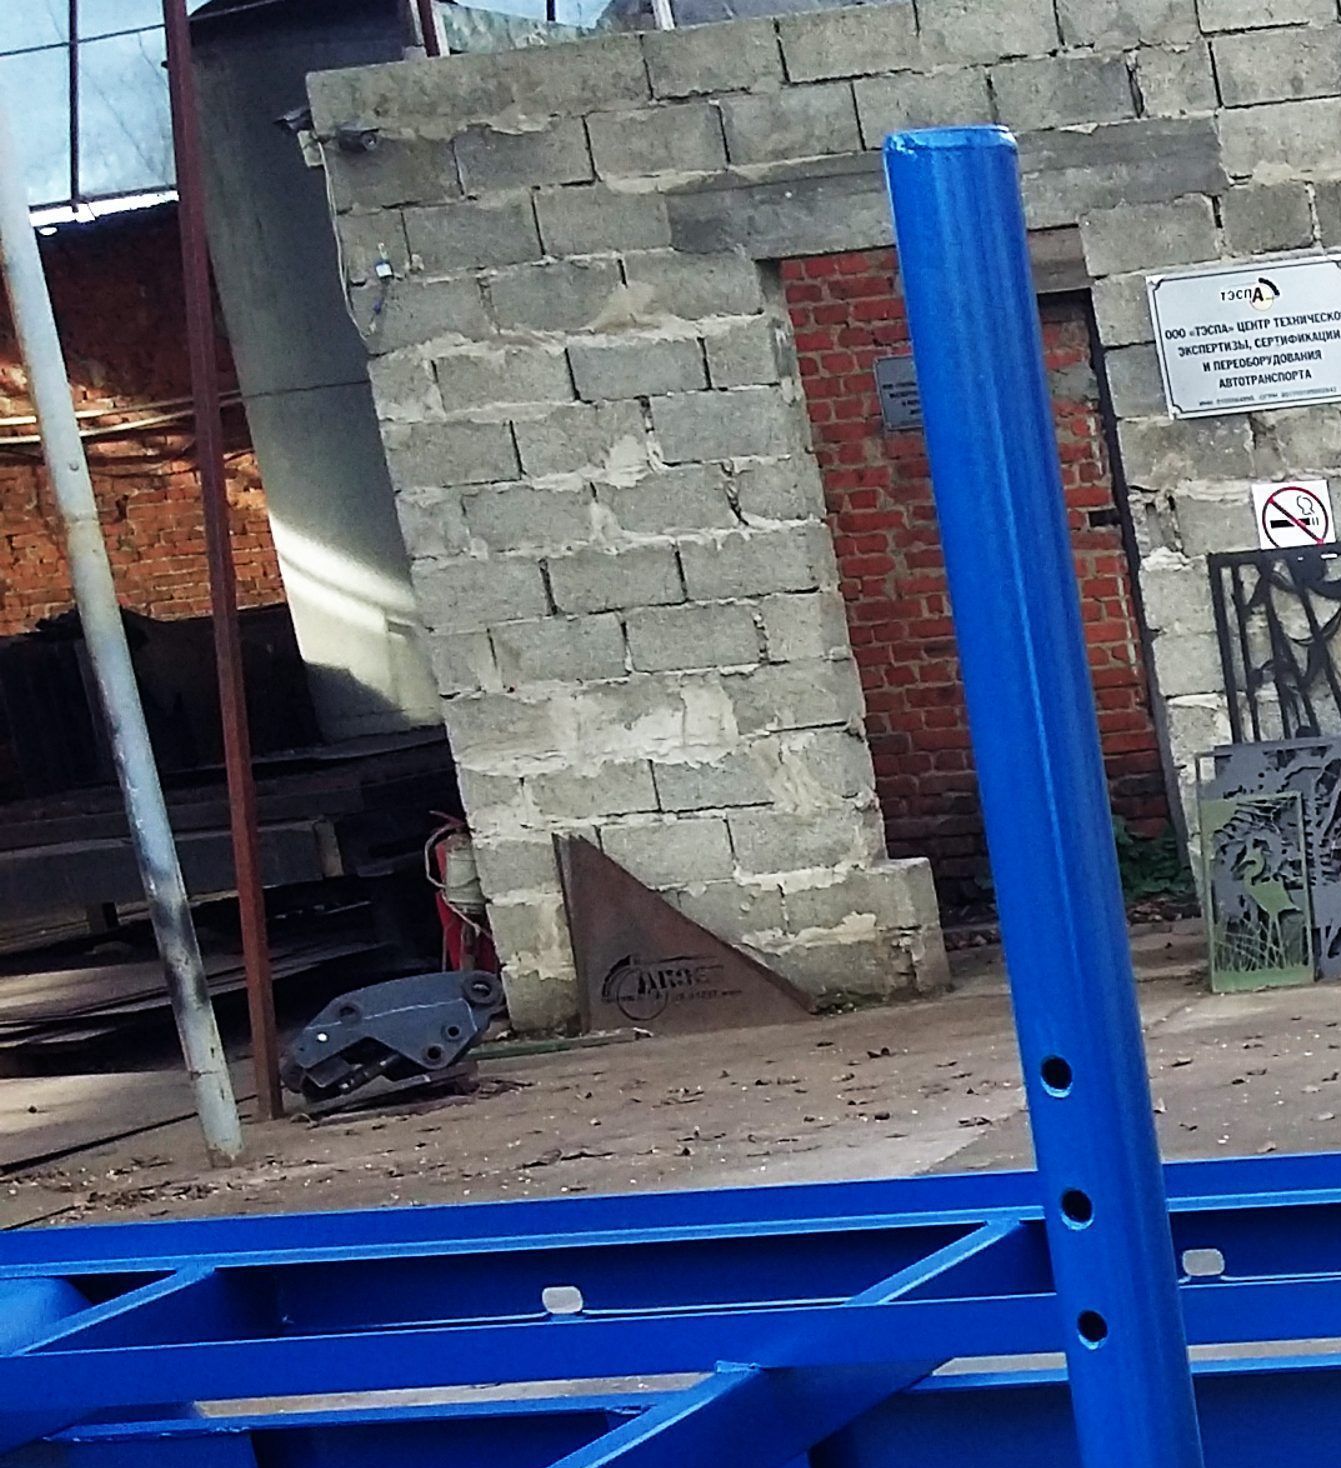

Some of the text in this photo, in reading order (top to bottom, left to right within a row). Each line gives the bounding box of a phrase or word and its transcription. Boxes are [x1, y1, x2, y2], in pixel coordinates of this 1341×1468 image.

[1220, 287, 1264, 303] ТЭСПА
[1164, 328, 1187, 340] ООО
[1189, 323, 1234, 337] «ТЭСПА»
[1236, 319, 1271, 333] ЦЕНТР
[1178, 329, 1341, 357] ЭКСПЕРТИЗЫ, СЕРТИФИКАЦИИ
[1202, 349, 1323, 373] И ПЕРЕОБОРУДОВАНИЯ
[1218, 369, 1313, 388] АВТОТРАНСПОРТА
